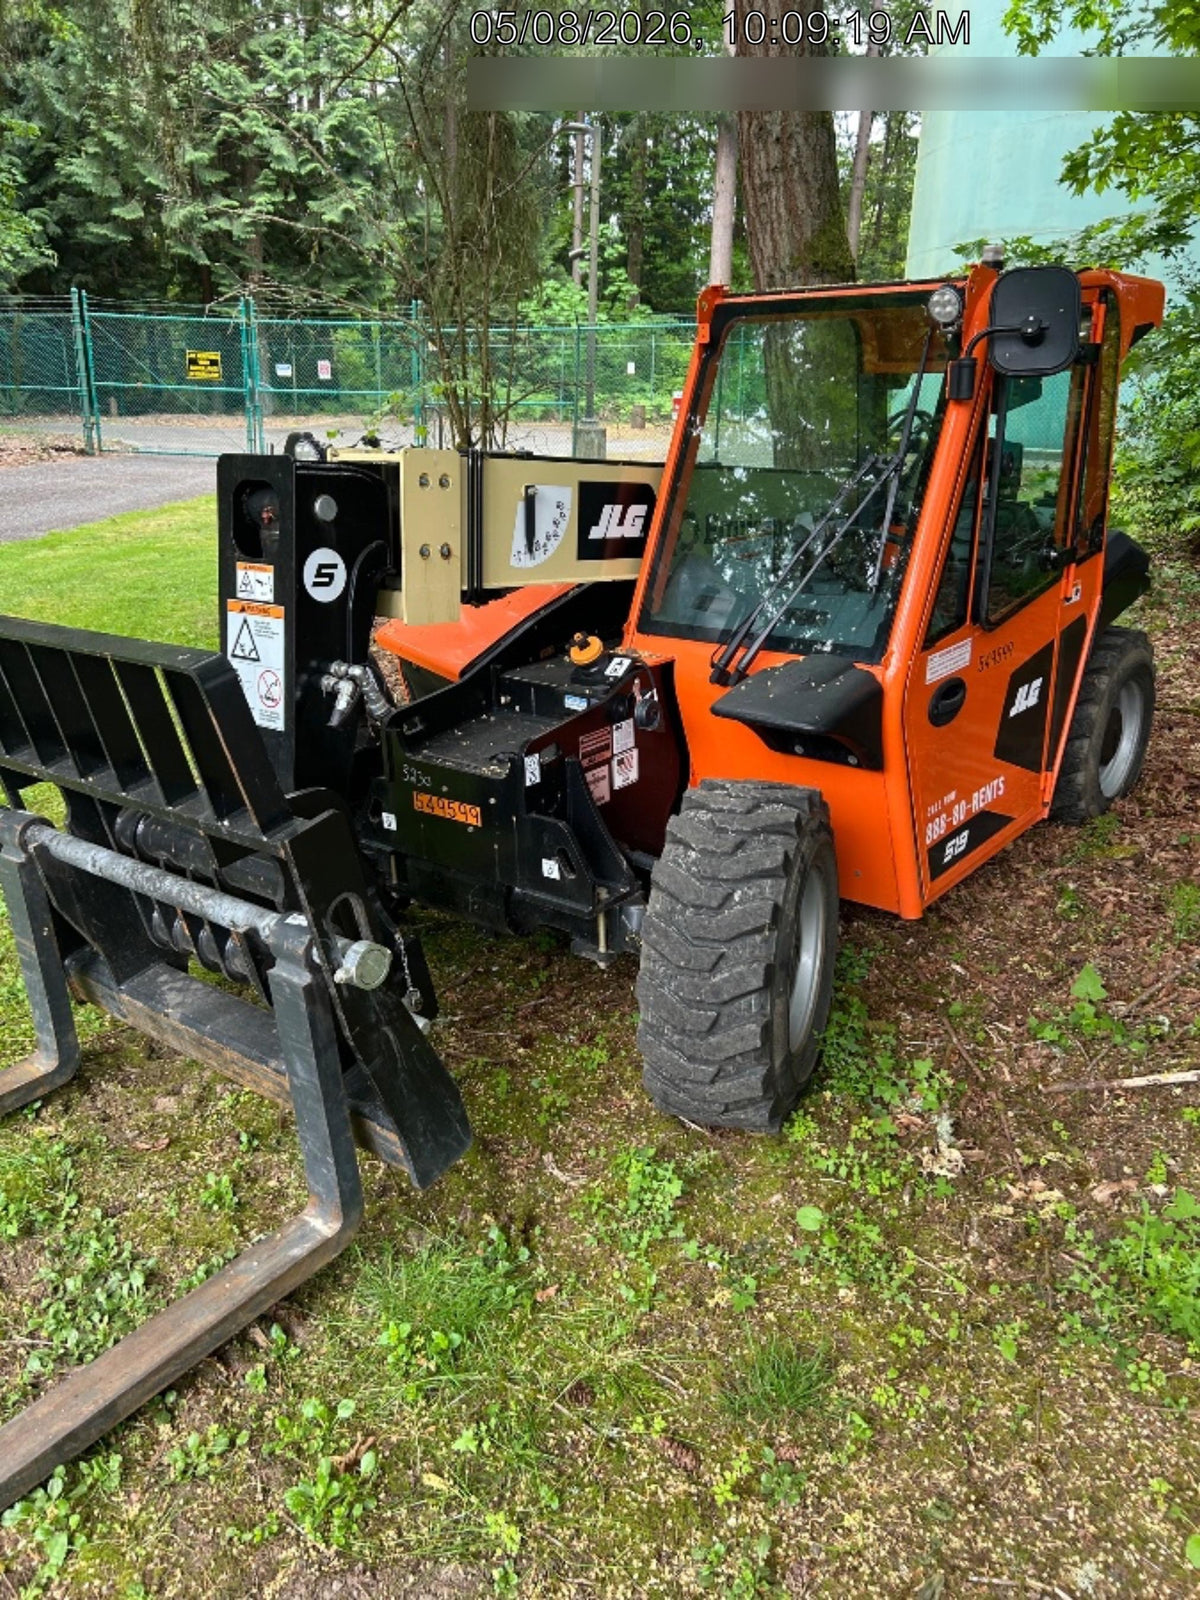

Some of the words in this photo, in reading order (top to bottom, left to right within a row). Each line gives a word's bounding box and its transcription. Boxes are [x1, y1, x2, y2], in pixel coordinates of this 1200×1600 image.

[588, 504, 648, 539] JLG
[1009, 676, 1043, 718] JLG
[415, 792, 480, 824] 549599
[925, 775, 1005, 846] 888-80-RENTS
